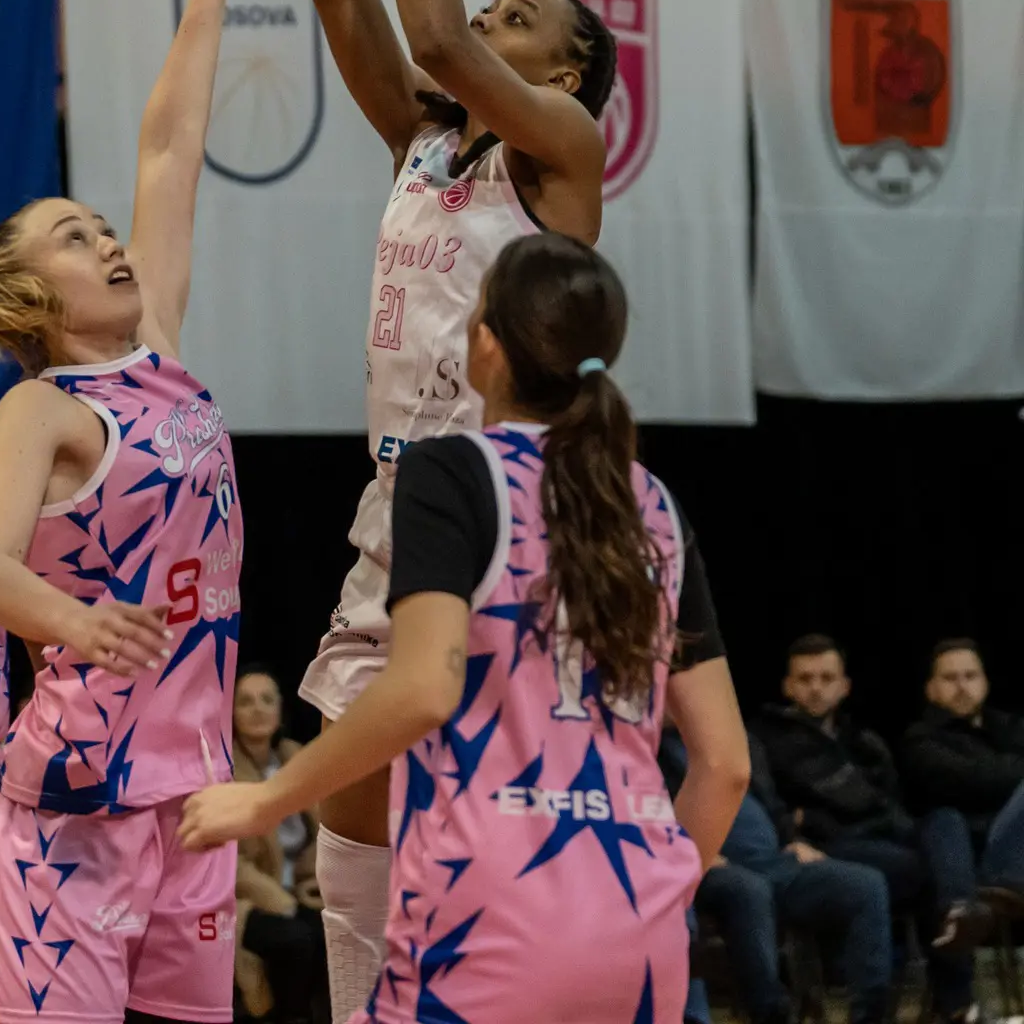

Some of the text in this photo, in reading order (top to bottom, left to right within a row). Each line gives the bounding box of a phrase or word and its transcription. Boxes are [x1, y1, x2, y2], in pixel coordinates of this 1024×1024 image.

[376, 224, 462, 275] eja03
[372, 284, 406, 351] 21
[497, 786, 611, 821] EXFIS
